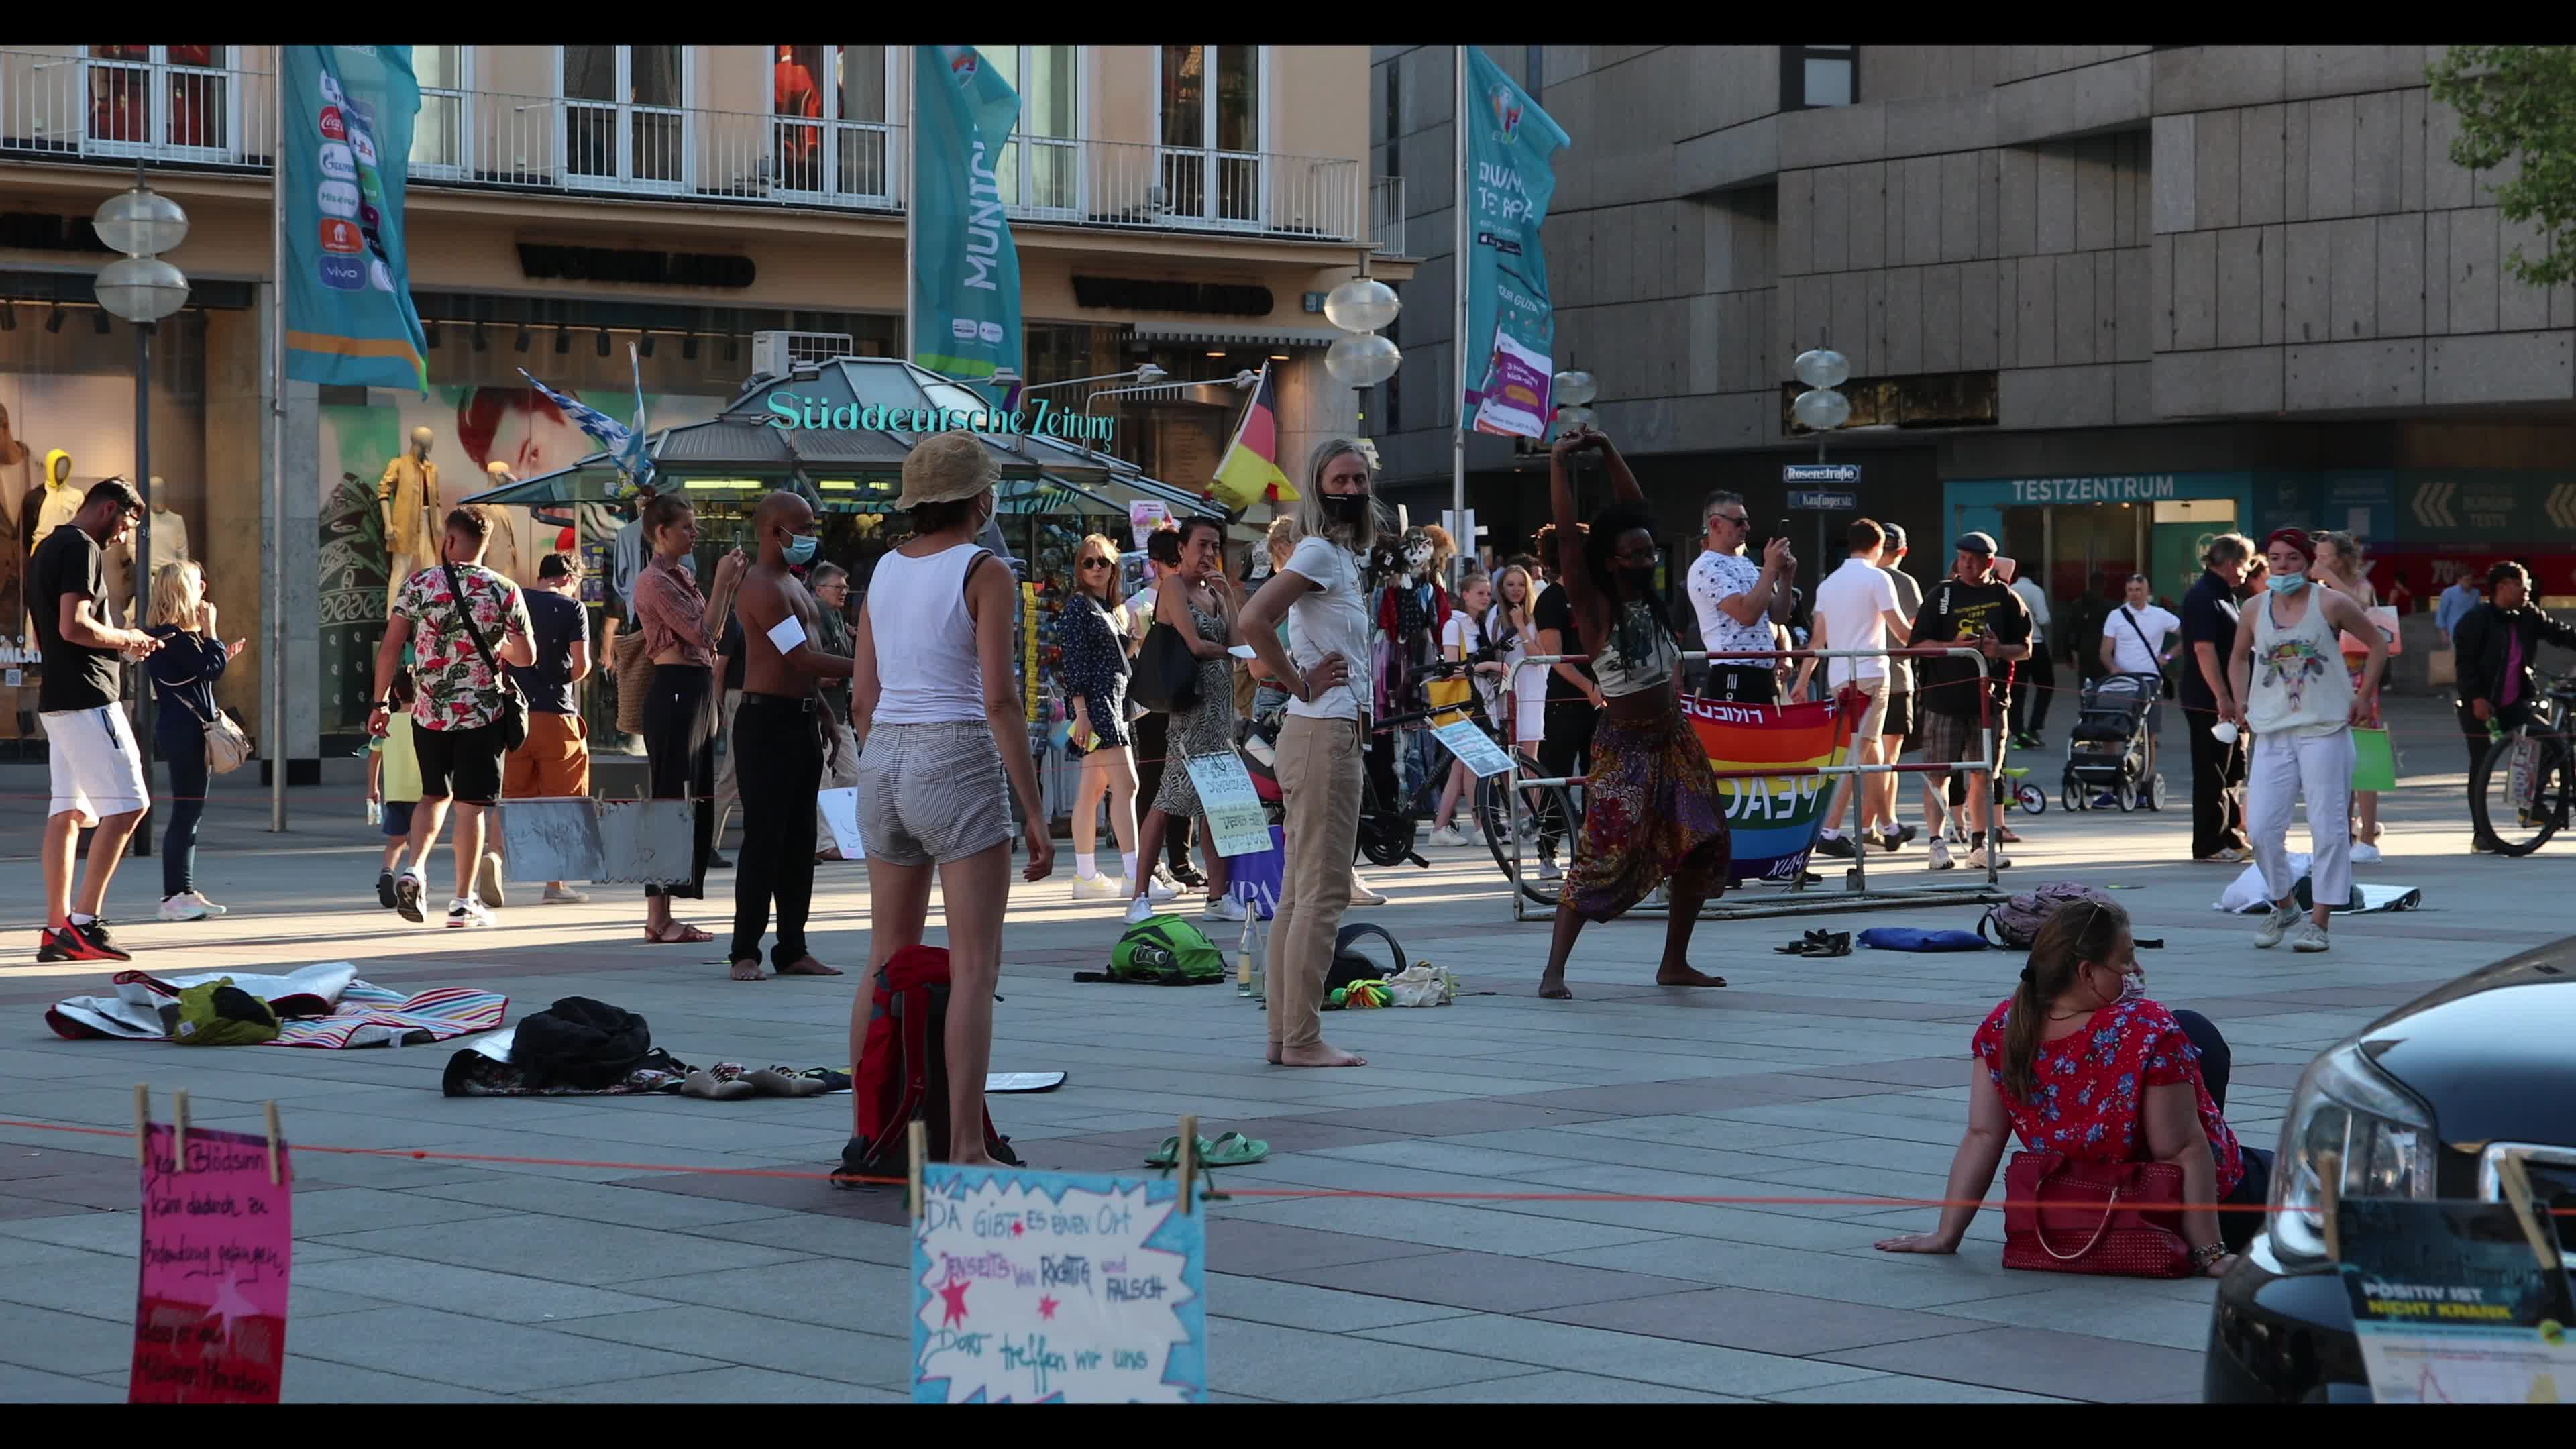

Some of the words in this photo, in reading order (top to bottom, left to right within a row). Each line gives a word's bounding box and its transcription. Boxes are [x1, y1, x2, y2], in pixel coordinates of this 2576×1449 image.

[327, 266, 358, 278] vivo
[766, 391, 1026, 436] Süddeutsche
[1031, 398, 1114, 453] Zeitung
[1788, 468, 1854, 481] Rosenstraße
[2012, 476, 2174, 501] TESTZENTRUM
[925, 1200, 963, 1232] DA
[1026, 1210, 1048, 1230] ES
[1101, 1256, 1128, 1273] und
[2361, 1282, 2444, 1300] POSITIV
[2449, 1286, 2482, 1301] IST
[2367, 1299, 2430, 1316] NICHT
[998, 1332, 1068, 1395] treffen
[1074, 1348, 1104, 1369] wir
[1112, 1348, 1149, 1370] uns
